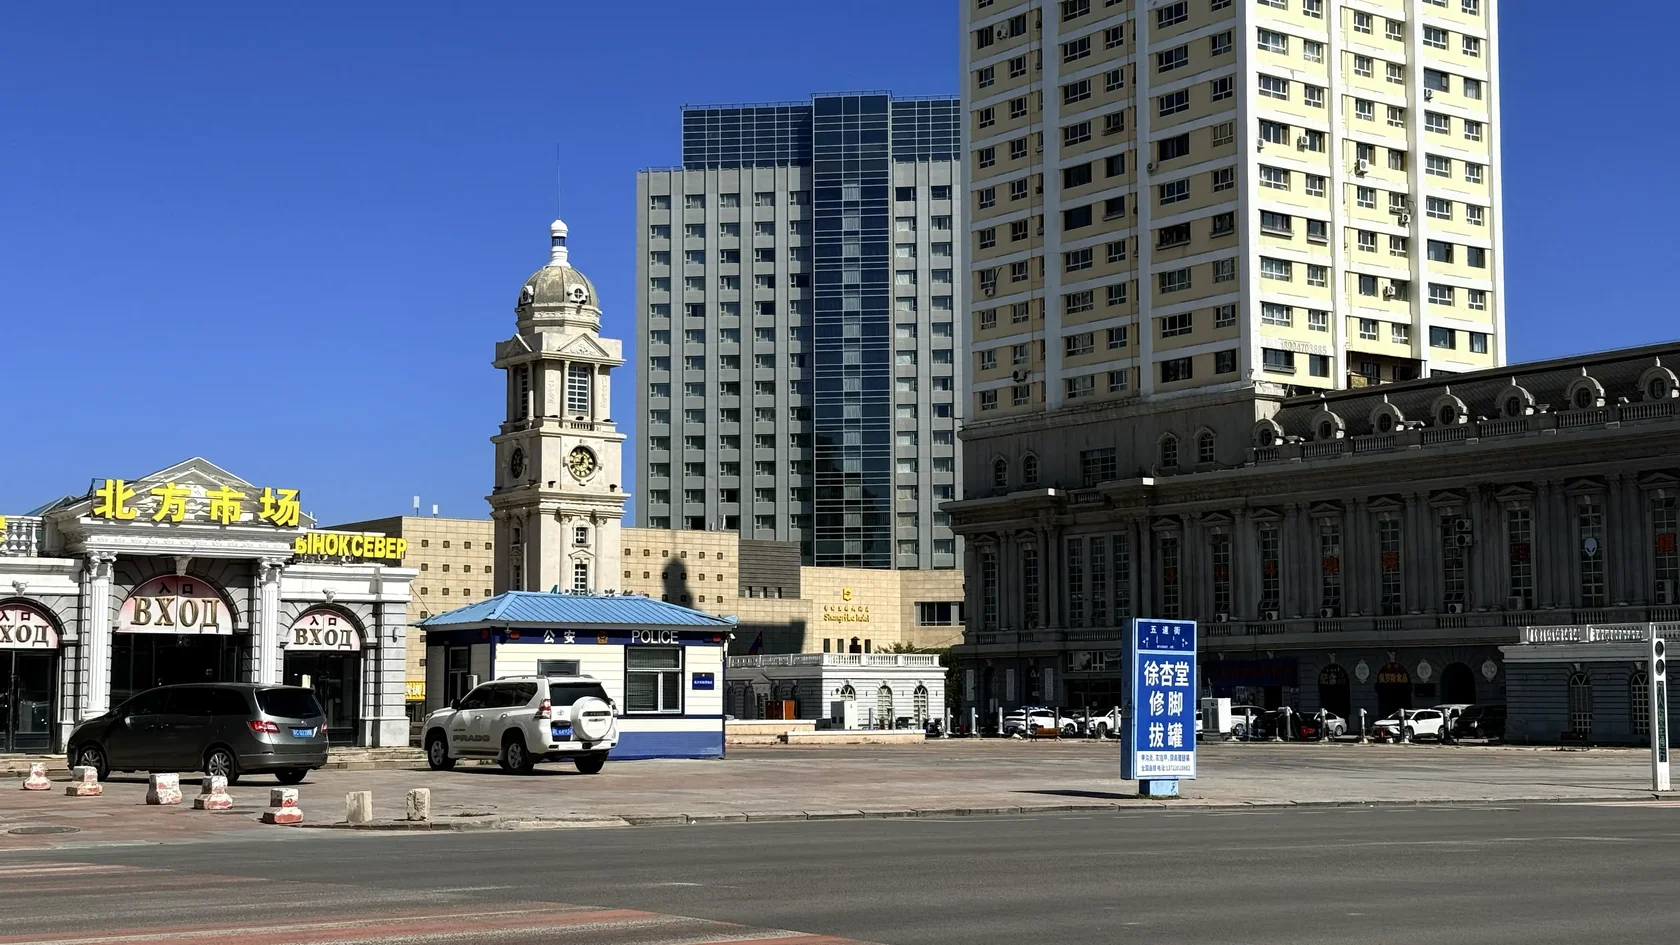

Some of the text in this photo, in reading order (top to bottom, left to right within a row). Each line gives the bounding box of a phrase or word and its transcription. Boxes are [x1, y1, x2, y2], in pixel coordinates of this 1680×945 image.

[93, 478, 300, 527] 北方市场
[159, 581, 194, 595] 入口
[0, 610, 31, 621] 入口
[130, 595, 220, 634] ВХОД
[310, 616, 337, 626] 入口
[0, 624, 49, 647] ХОД
[293, 628, 353, 650] ВХОД
[543, 629, 576, 644] 公安
[631, 629, 679, 644] POLICE
[1150, 625, 1181, 635] 五道街
[1143, 660, 1189, 687] 徐杏堂
[1149, 690, 1183, 717] 修脚
[453, 734, 491, 742] PRADO
[1149, 721, 1183, 748] 拔罐
